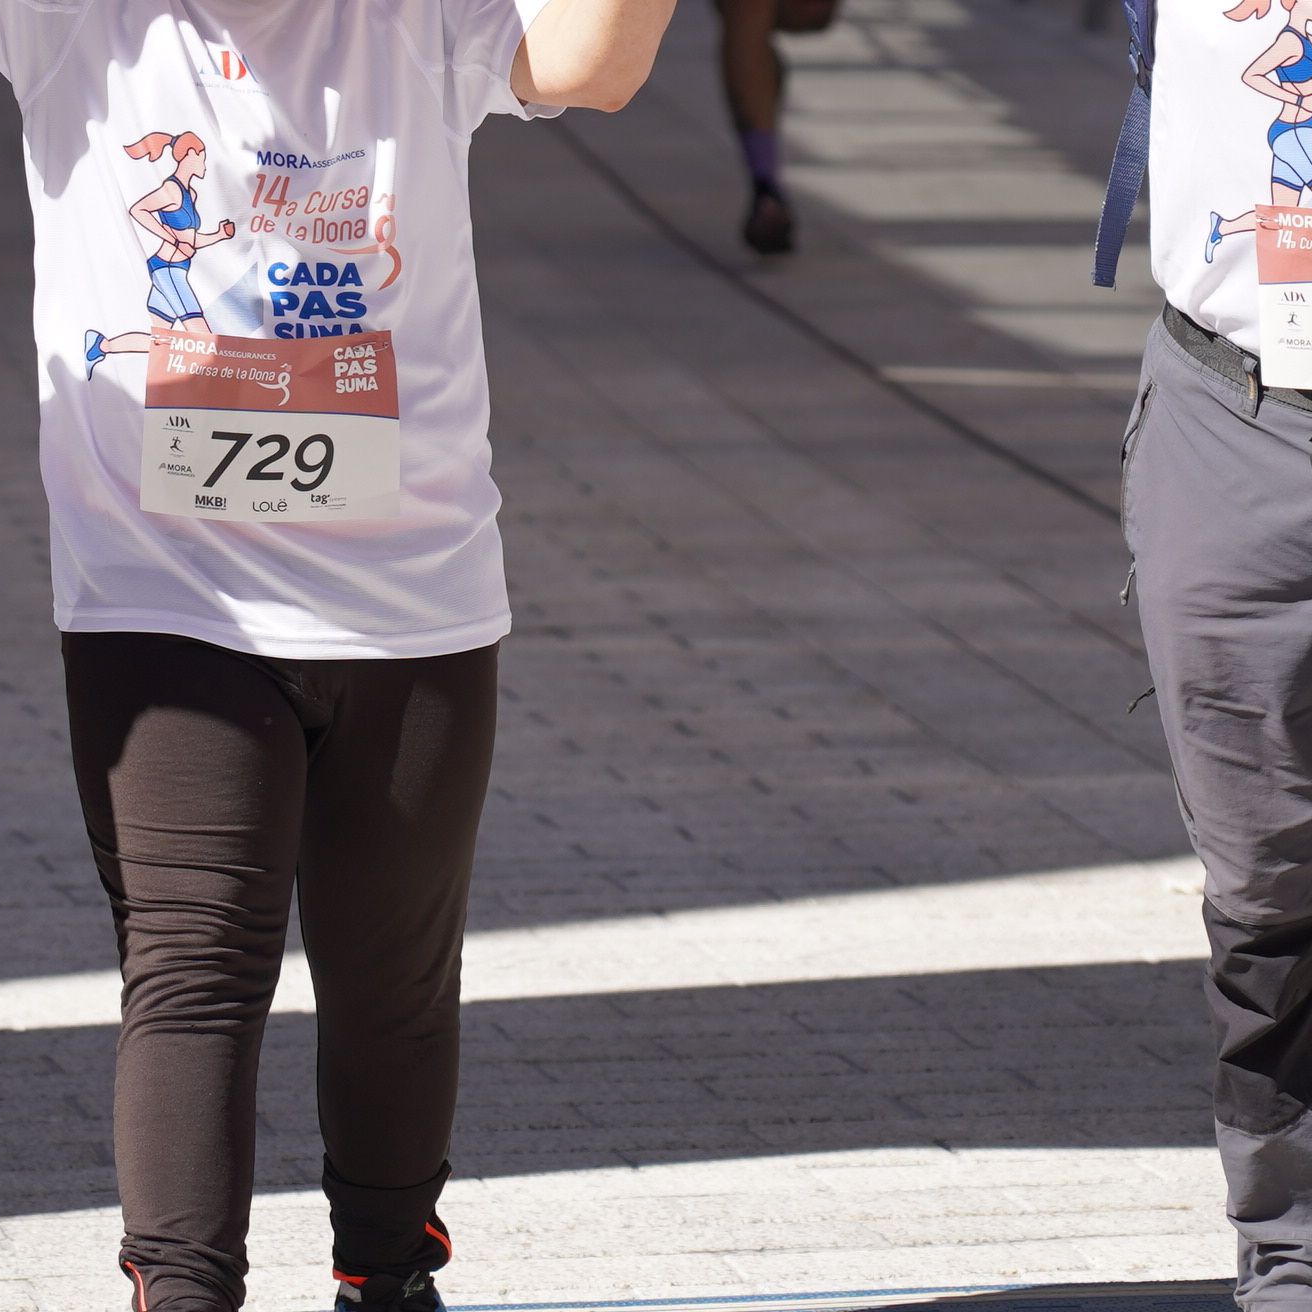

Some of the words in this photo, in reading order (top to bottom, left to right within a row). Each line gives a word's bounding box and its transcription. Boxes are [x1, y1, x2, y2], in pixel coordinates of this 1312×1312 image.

[257, 150, 312, 168] MORA
[304, 186, 369, 214] Cursa
[250, 214, 276, 232] de
[286, 222, 307, 241] la
[312, 217, 367, 244] Dona
[268, 262, 364, 286] CADA
[269, 291, 367, 319] PAS
[169, 336, 218, 355] MORA
[219, 350, 277, 361] ASSEGURANCES
[1286, 338, 1312, 346] MORA
[334, 345, 376, 360] CADA
[189, 362, 219, 376] Cursa
[220, 366, 234, 378] de
[236, 368, 247, 379] la
[248, 368, 276, 381] Dona
[334, 360, 378, 377] PAS
[336, 377, 378, 393] SUMA
[168, 464, 192, 473] MORA
[202, 431, 335, 492] 729
